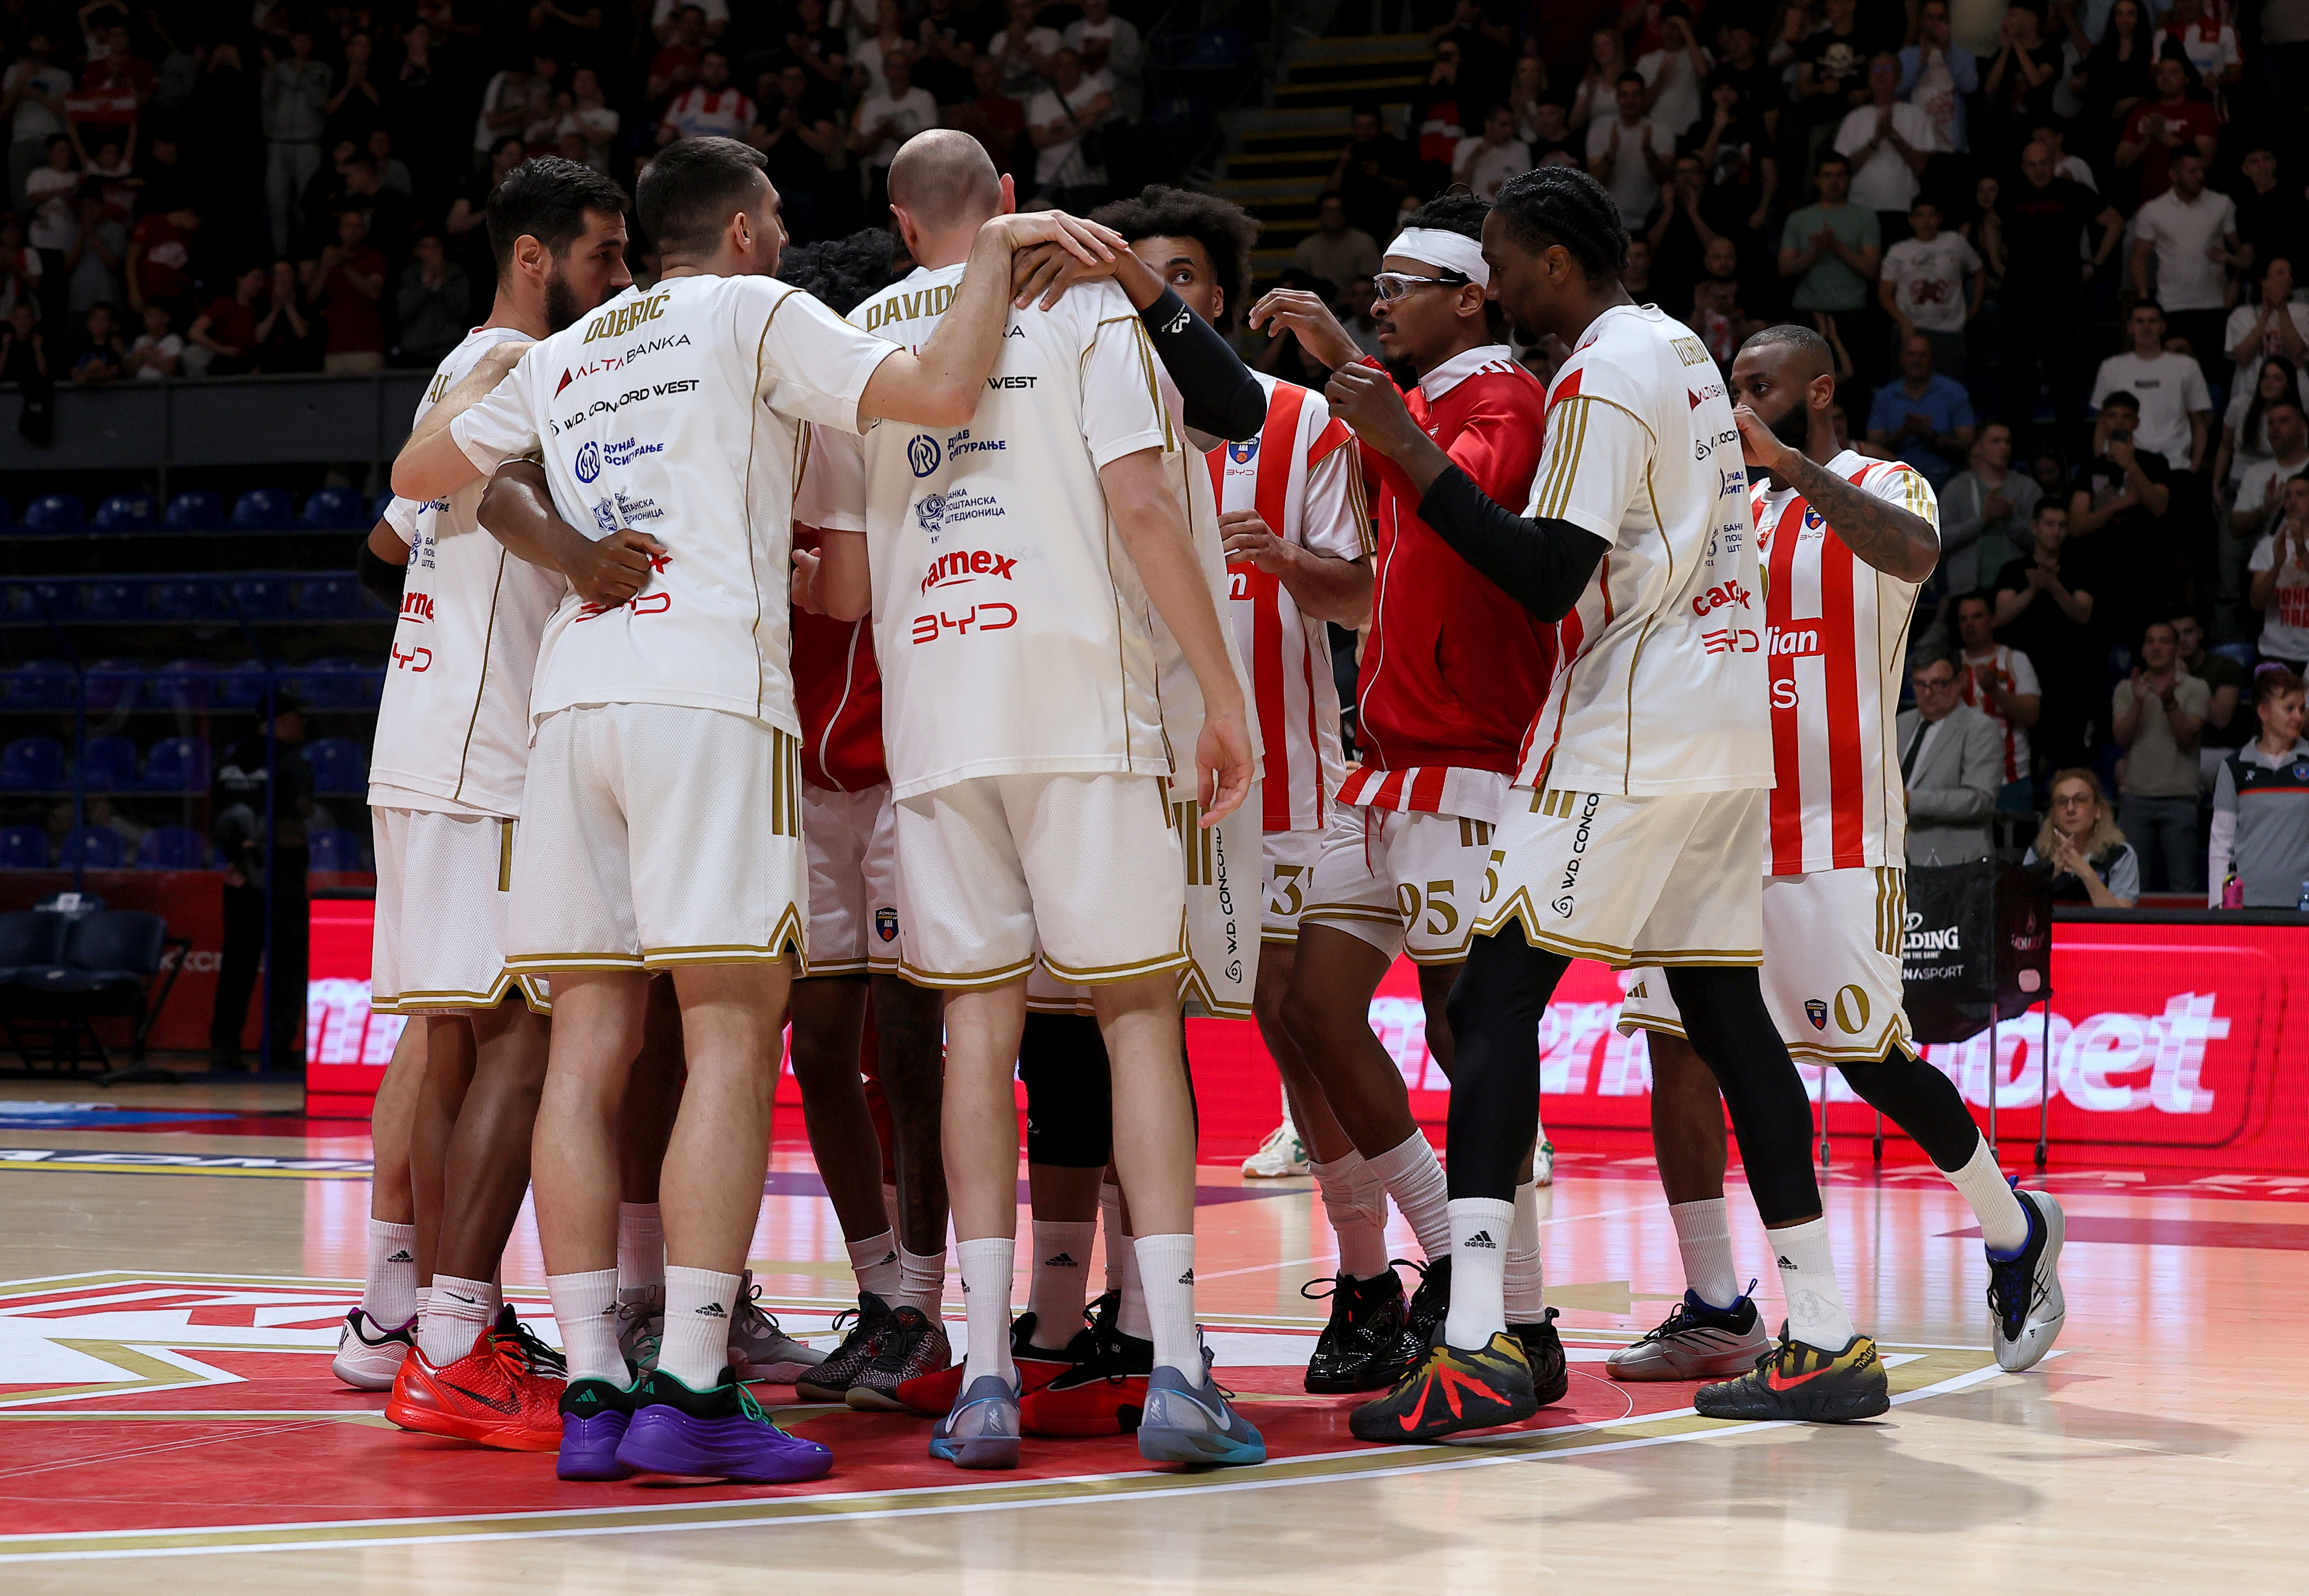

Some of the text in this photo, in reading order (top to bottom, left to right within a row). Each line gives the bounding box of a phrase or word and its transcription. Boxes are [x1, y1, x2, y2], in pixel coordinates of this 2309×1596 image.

[582, 288, 671, 345] DOBRIĆ
[575, 334, 691, 380] ALTABANKA
[987, 376, 1038, 390] WEST
[564, 380, 699, 430] W.D. CONORD WEST
[604, 437, 636, 455] ДУНАВ
[619, 498, 655, 514] ШТАНСКА
[945, 496, 997, 513] ПОШТАНСКА
[945, 507, 1006, 524] ШТЕДИОНИЦА
[1799, 532, 1823, 540] BYD
[912, 602, 1018, 645] BYD
[392, 642, 432, 673] YD
[1561, 793, 1599, 889] W.D. CONCO
[1396, 879, 1459, 936] 95
[1226, 919, 1238, 956] W.D.
[1903, 925, 1960, 950] LDING
[1834, 984, 1870, 1034] 0
[1464, 1240, 1496, 1249] adidas
[695, 1308, 728, 1319] adidas
